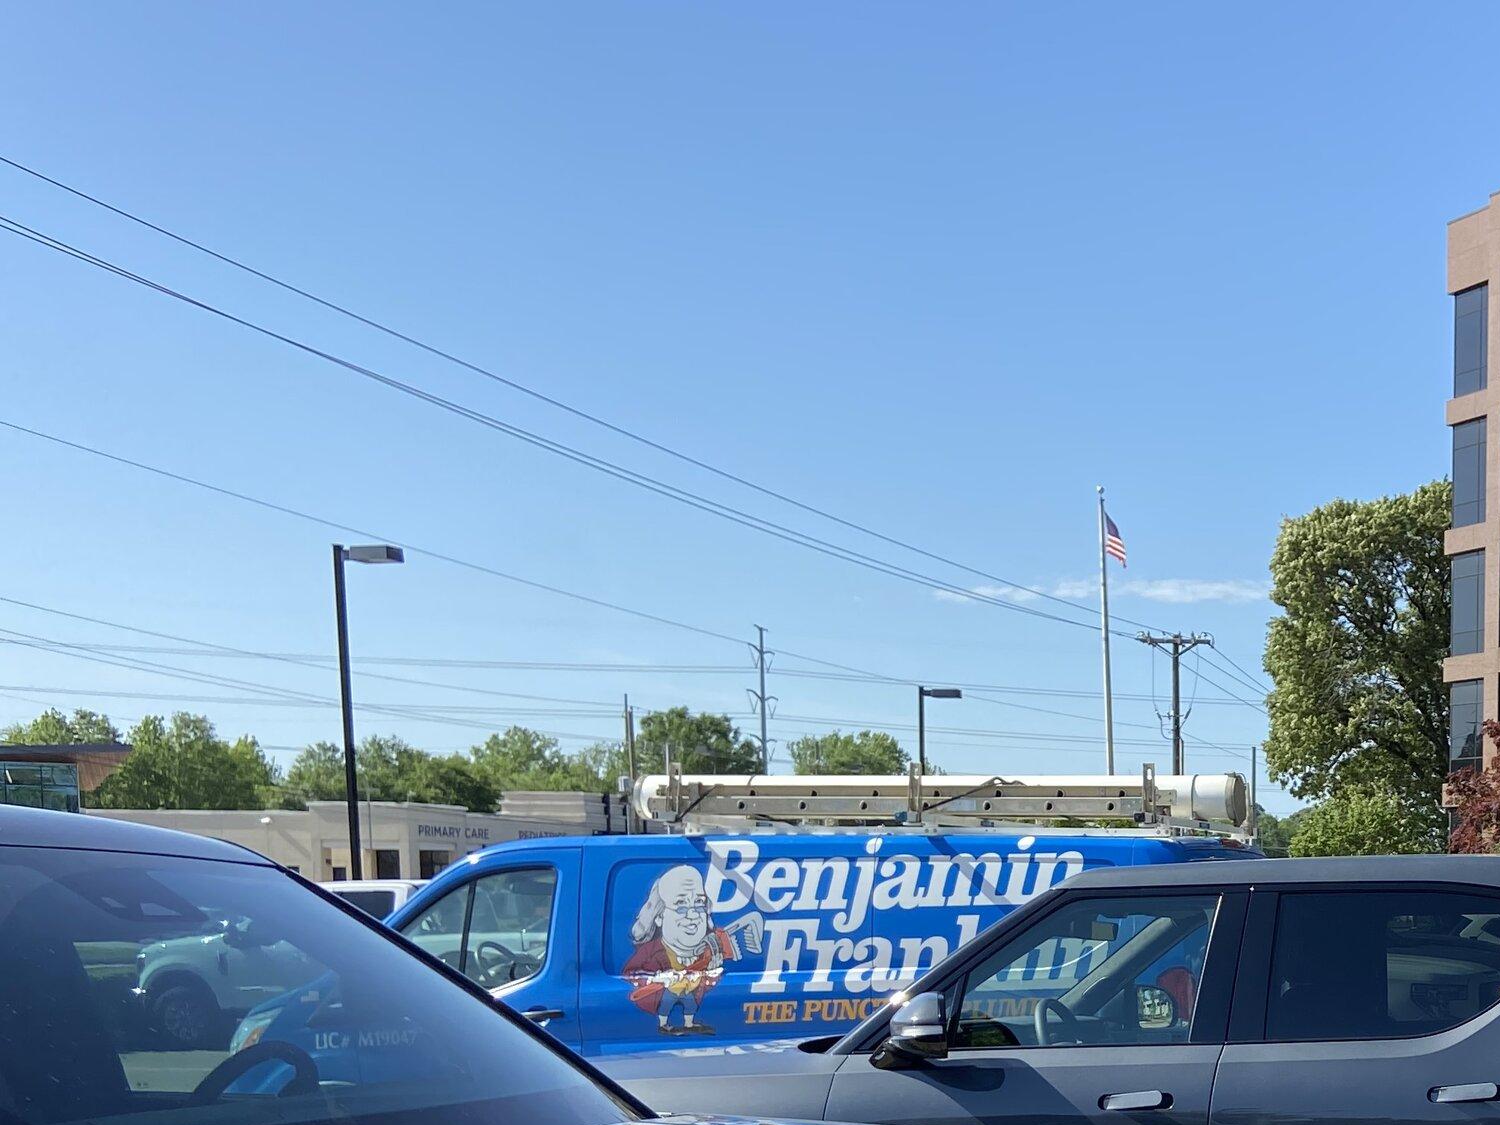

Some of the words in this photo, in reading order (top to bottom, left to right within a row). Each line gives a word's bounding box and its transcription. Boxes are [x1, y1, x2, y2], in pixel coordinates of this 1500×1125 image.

[418, 824, 461, 838] PRIMARY
[464, 827, 490, 840] CARE
[706, 835, 1085, 934] Benjamin
[743, 999, 798, 1024] THE
[315, 1031, 351, 1050] LIC#
